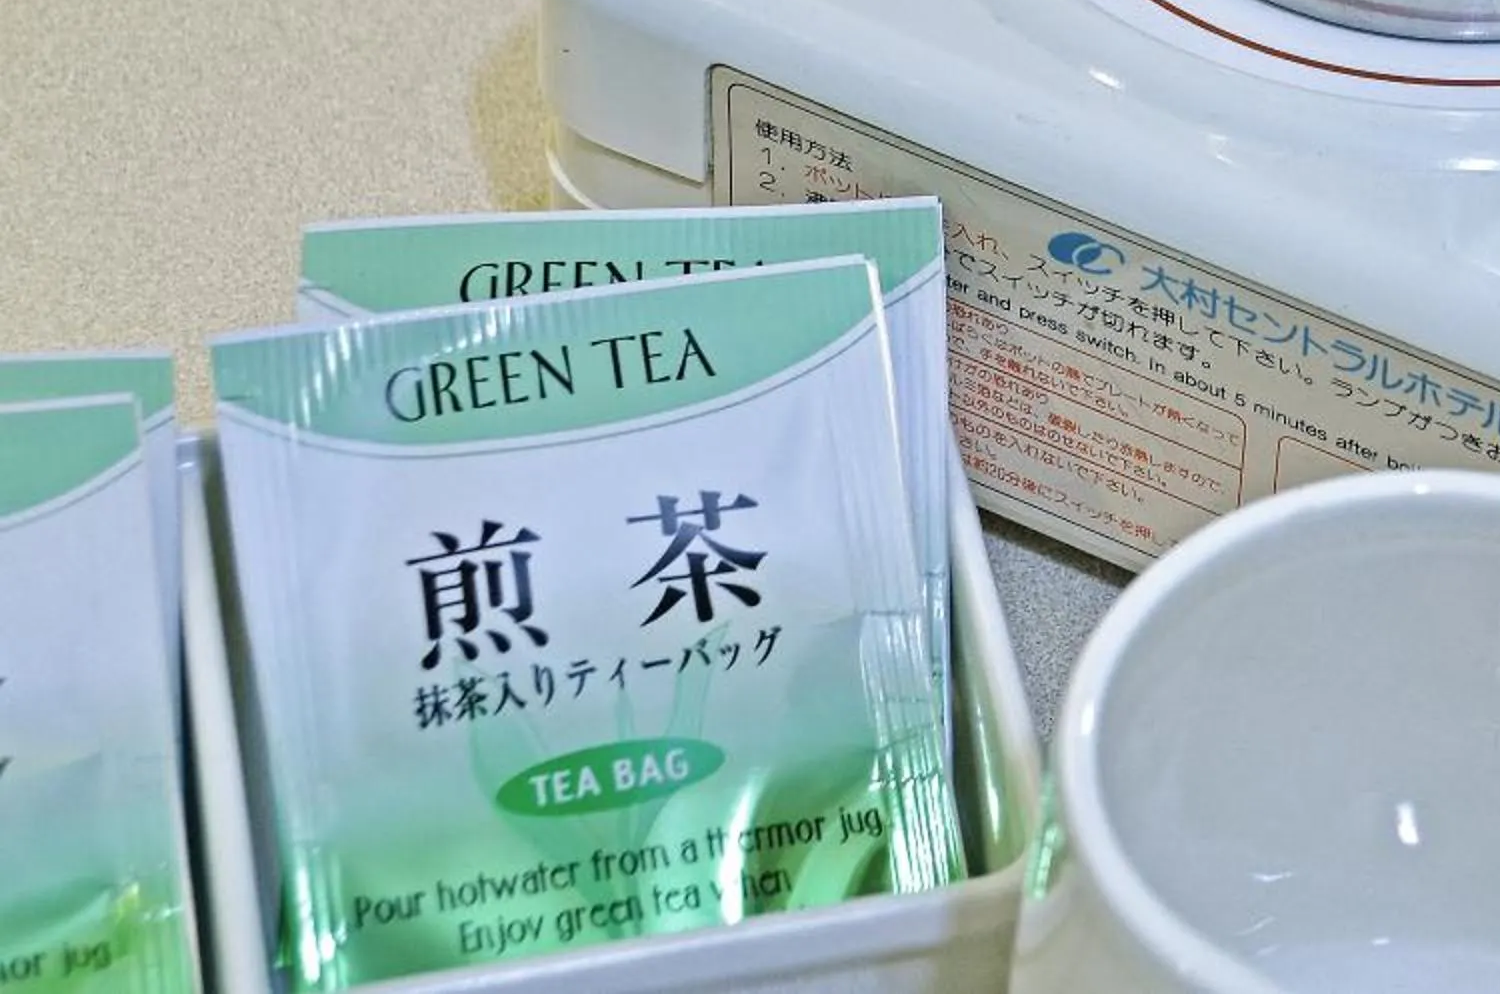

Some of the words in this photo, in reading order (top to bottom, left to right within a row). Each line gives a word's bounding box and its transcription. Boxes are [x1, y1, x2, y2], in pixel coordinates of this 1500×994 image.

[755, 118, 853, 173] 使用方法
[803, 163, 893, 200] ポット
[385, 344, 575, 424] GREEN
[590, 327, 717, 390] TEA
[977, 287, 1011, 311] and
[1019, 306, 1068, 335] press
[1149, 356, 1166, 375] In
[1174, 369, 1227, 401] about
[1234, 392, 1248, 408] 5
[1253, 402, 1328, 442] minutes
[1335, 436, 1379, 462] after
[405, 490, 769, 670] 煎茶
[414, 625, 783, 730] 抹茶入りティーバッグ
[527, 764, 603, 807] TEA
[612, 747, 690, 792] BAG
[353, 889, 426, 930] Pour
[437, 860, 581, 912] hotwater
[590, 843, 671, 883] from
[680, 839, 700, 865] a
[838, 806, 883, 845] jug
[62, 941, 113, 979] jug
[458, 914, 544, 956] Enjoy
[554, 894, 644, 942] green
[652, 883, 701, 915] tea
